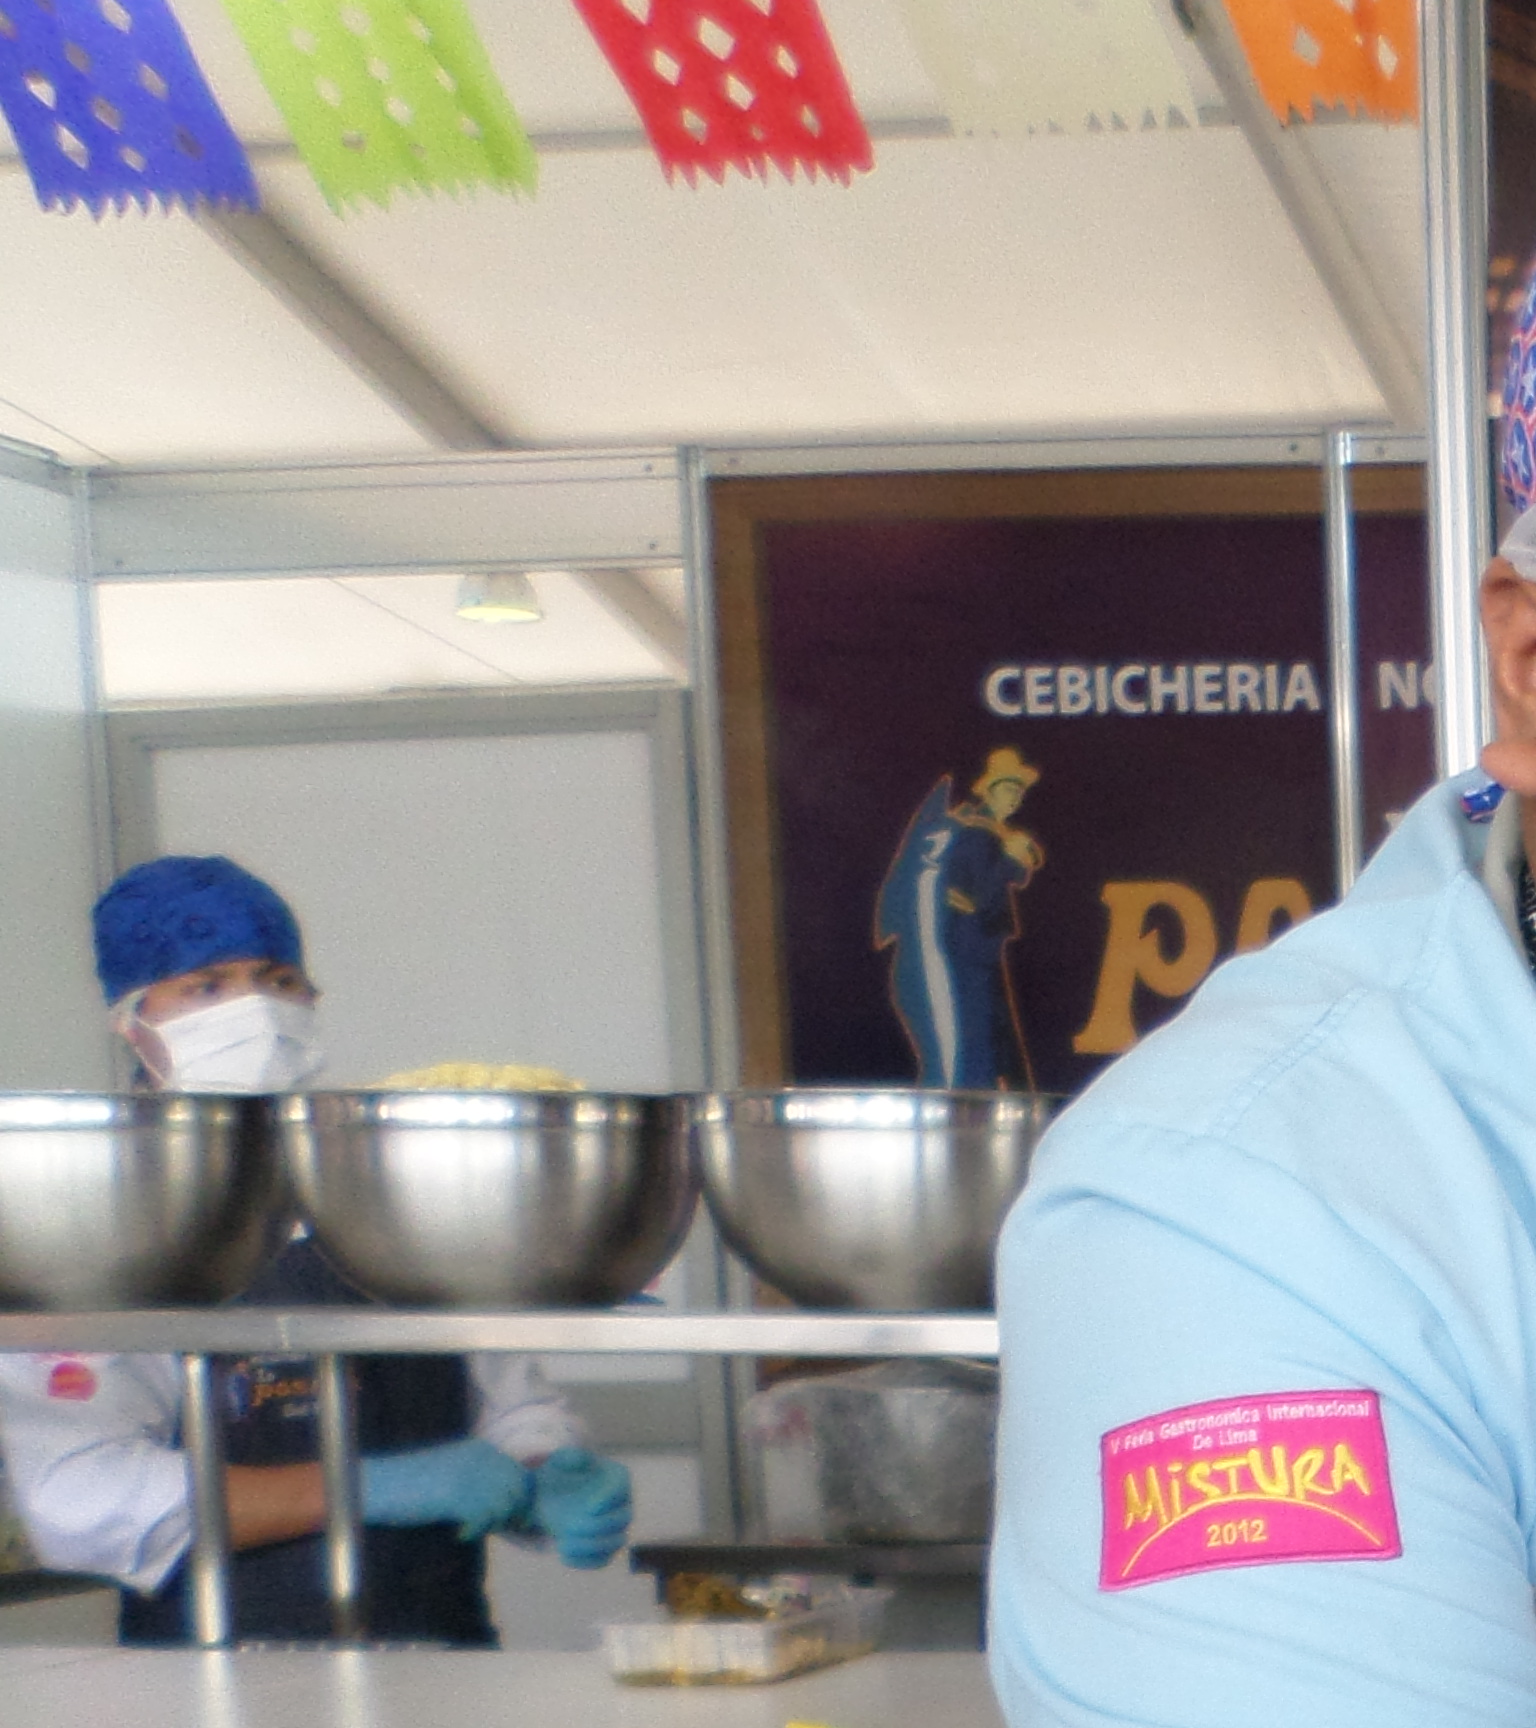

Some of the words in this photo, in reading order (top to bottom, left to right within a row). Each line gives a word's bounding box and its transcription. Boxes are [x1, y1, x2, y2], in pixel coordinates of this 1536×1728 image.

[985, 663, 1321, 715] CEBICHERIA
[1267, 1400, 1369, 1422] Internacional
[1193, 1433, 1212, 1450] De
[1219, 1428, 1257, 1445] Lima
[1207, 1520, 1267, 1546] 2012
